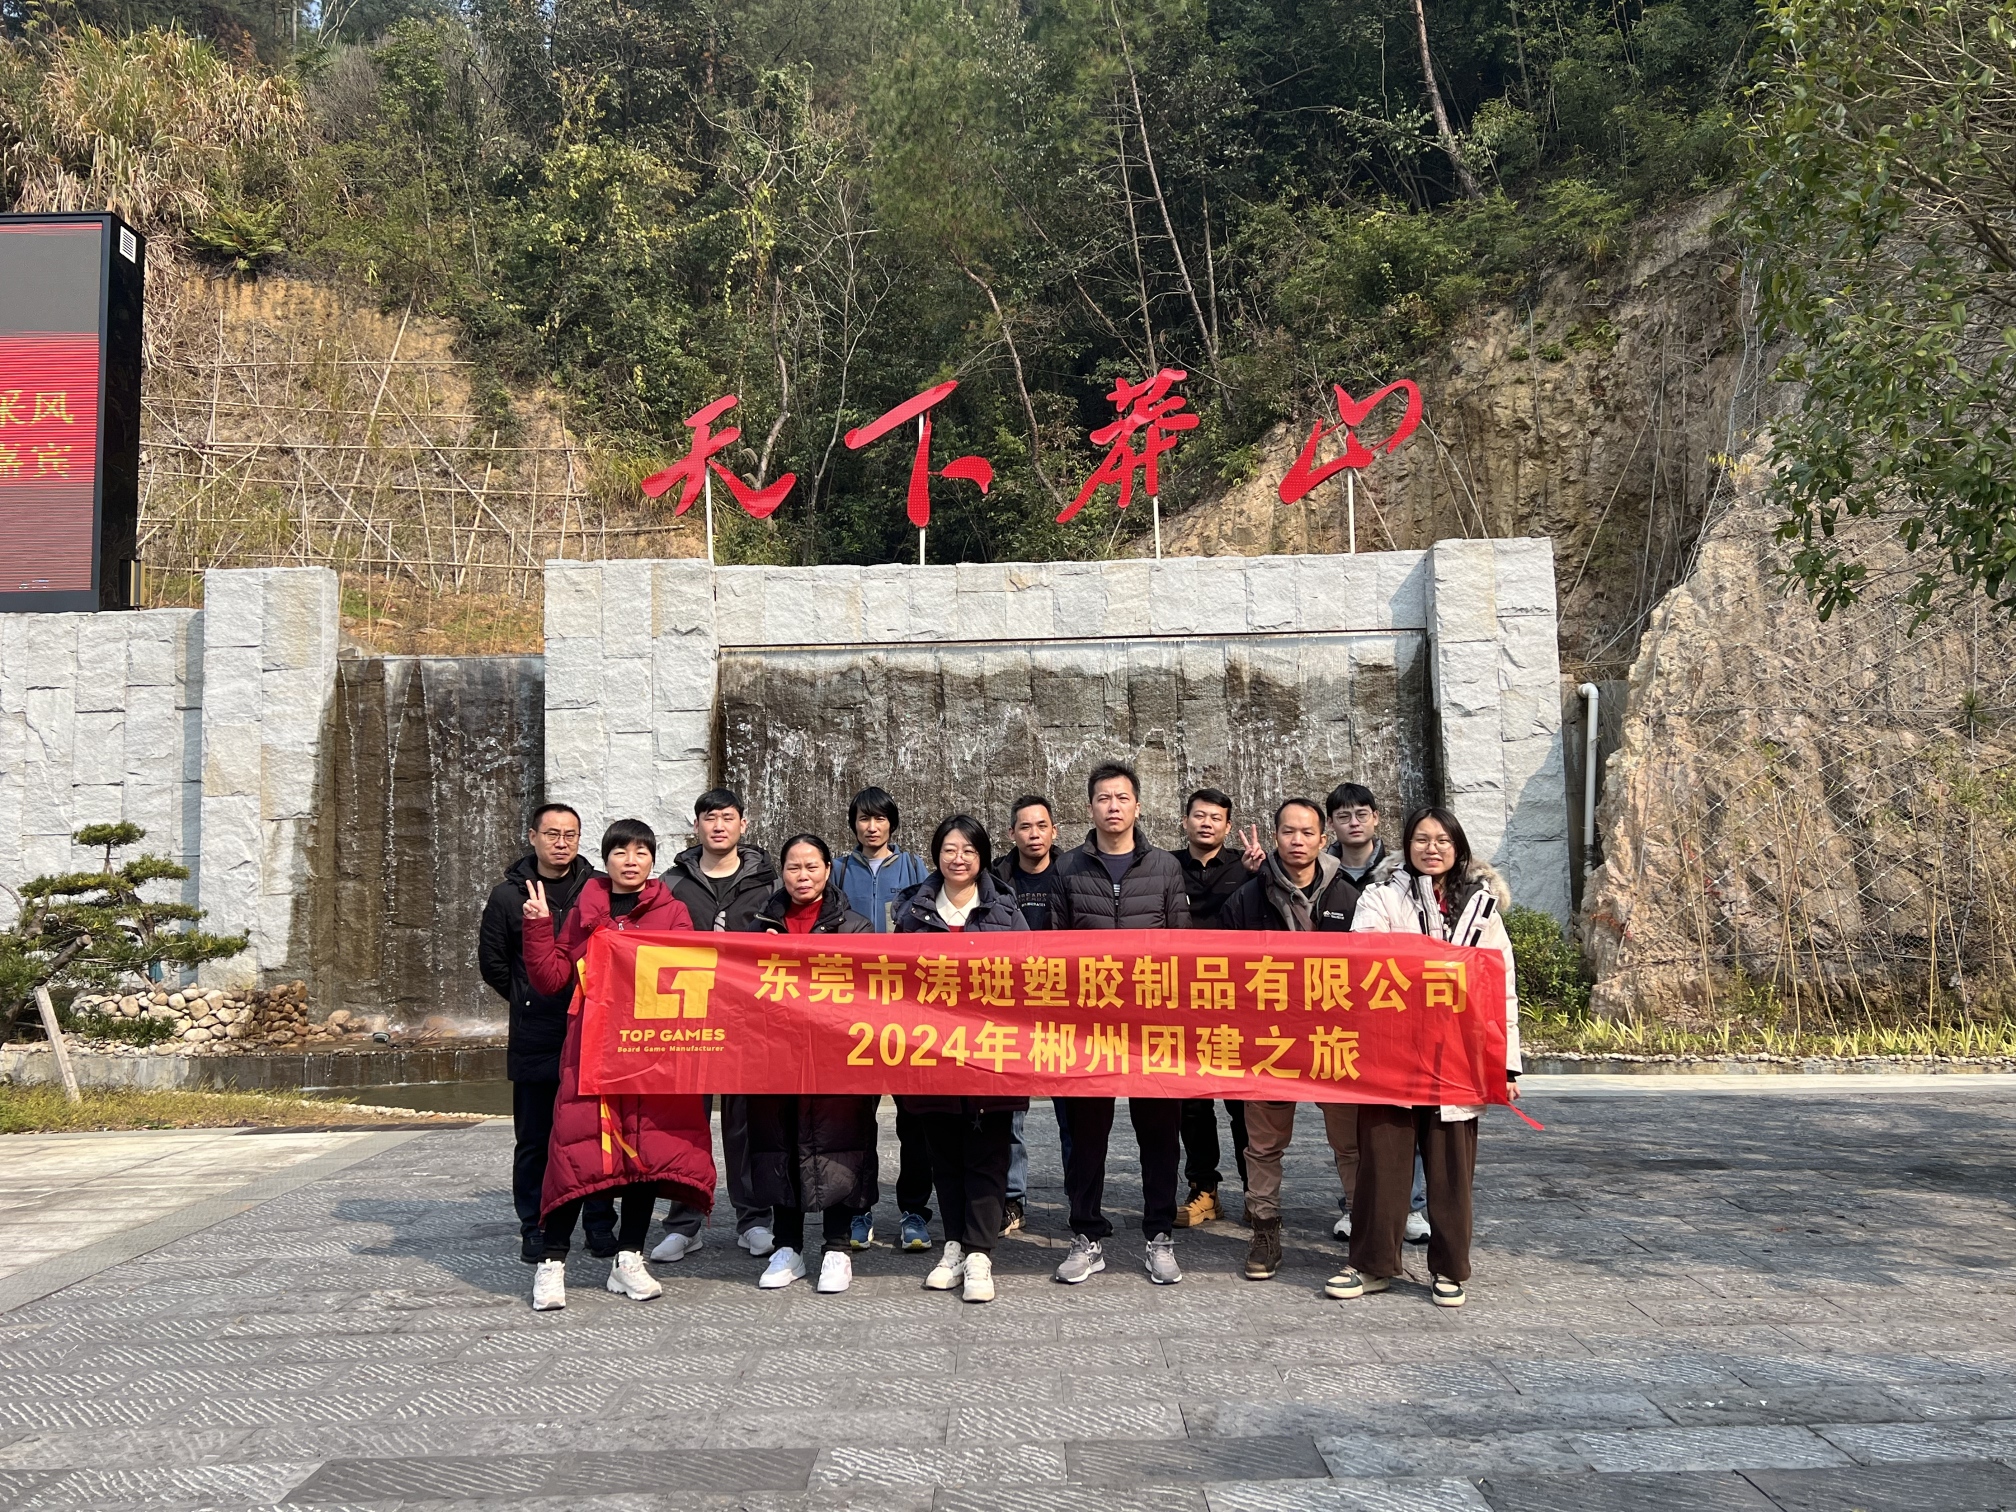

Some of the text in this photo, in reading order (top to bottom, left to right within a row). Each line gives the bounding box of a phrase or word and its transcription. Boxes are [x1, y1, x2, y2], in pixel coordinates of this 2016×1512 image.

[641, 368, 1425, 528] 天下莽山
[754, 953, 1467, 1014] 东莞市涛琎塑胶制品有限公司
[620, 1028, 726, 1042] TOP GAMES
[847, 1021, 1361, 1081] 2024年郴州团建之旅
